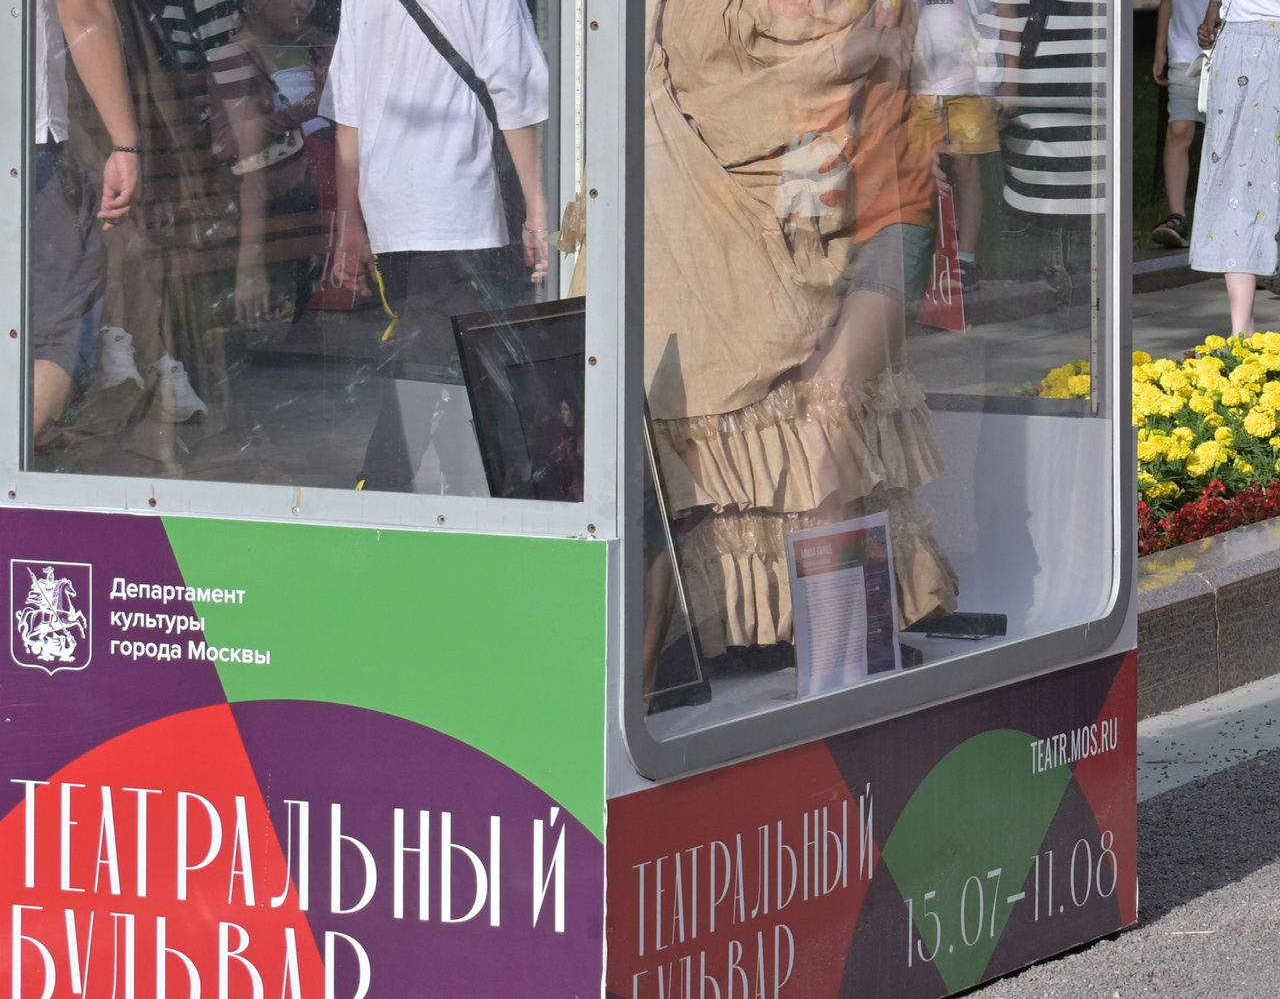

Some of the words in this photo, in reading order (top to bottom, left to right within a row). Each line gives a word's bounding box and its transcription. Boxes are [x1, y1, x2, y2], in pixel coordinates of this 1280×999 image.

[110, 577, 246, 605] Департамент
[110, 610, 205, 634] культуры
[110, 640, 182, 661] города
[188, 640, 271, 665] Москвы
[1031, 717, 1119, 774] TEATR.MOS.RU
[10, 778, 566, 933] ТЕАТРАЛЬНЫЙ
[632, 782, 874, 957] ТЕАТРАЛЬНЫЙ
[632, 924, 795, 999] ЛЬВАР
